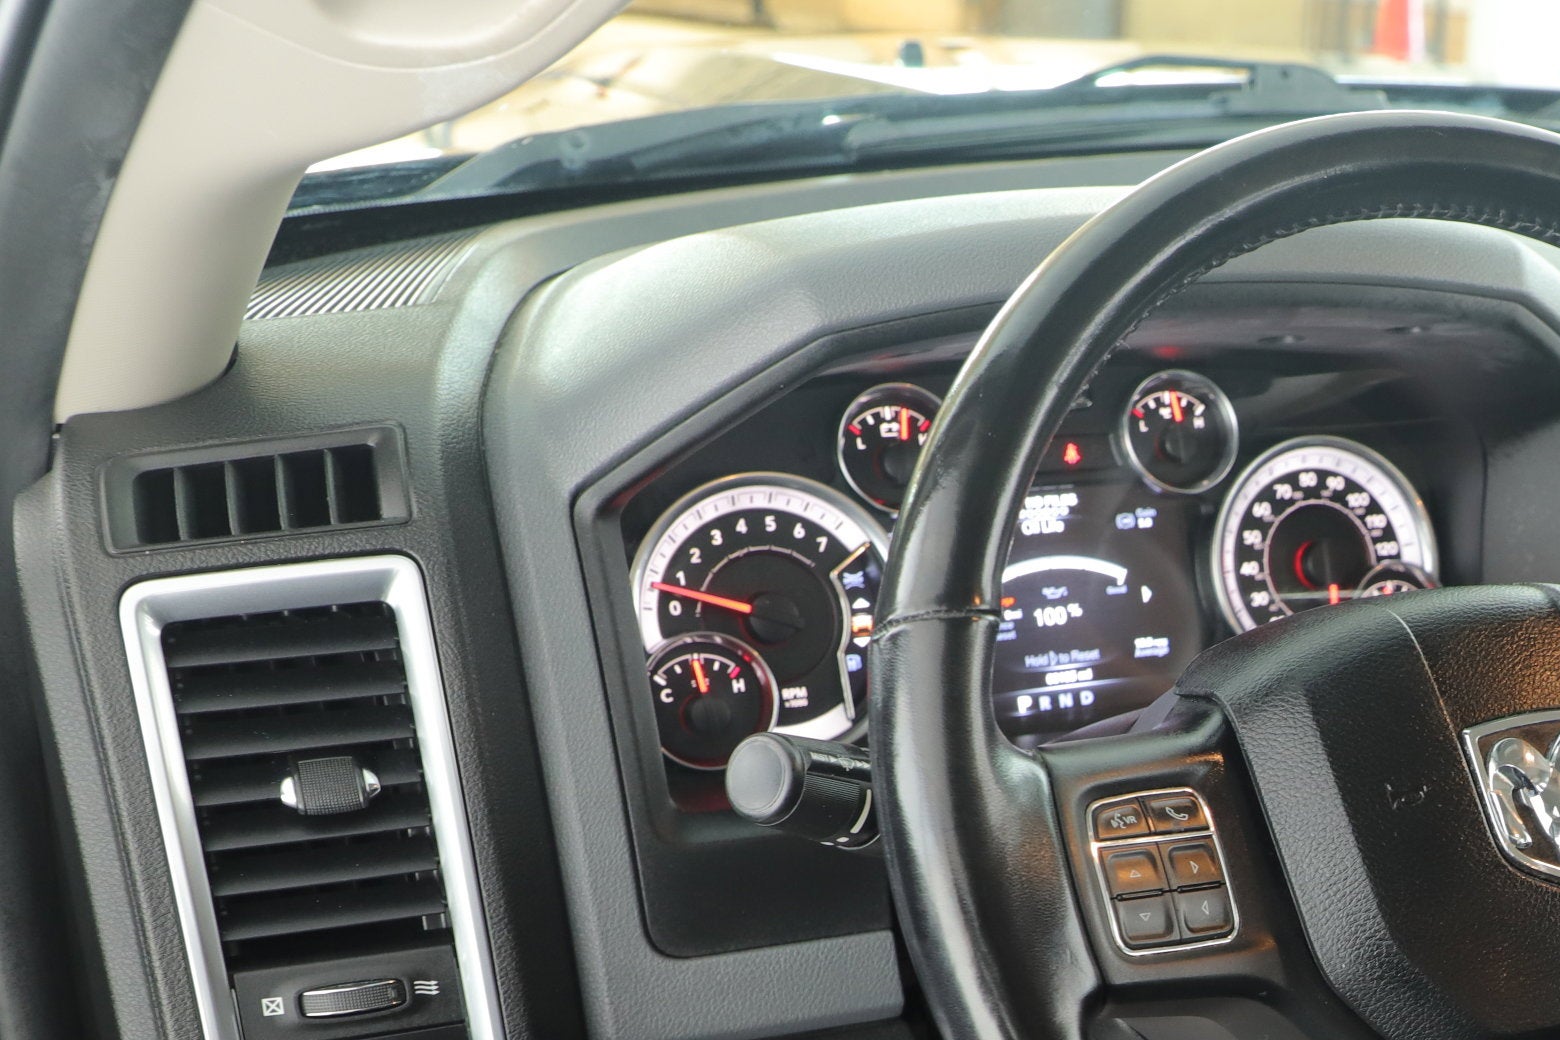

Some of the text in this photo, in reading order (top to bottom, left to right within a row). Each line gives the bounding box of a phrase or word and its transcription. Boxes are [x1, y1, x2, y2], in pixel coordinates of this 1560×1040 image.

[1138, 419, 1149, 433] L
[855, 436, 867, 450] L
[1298, 471, 1318, 488] 80
[1325, 475, 1346, 491] 90
[1273, 483, 1293, 500] 70
[1345, 491, 1371, 509] 100
[1251, 501, 1272, 519] 60
[735, 517, 748, 535] 4
[763, 515, 777, 532] 5
[1364, 513, 1388, 530] 110
[709, 529, 723, 546] 3
[792, 522, 806, 539] 6
[1242, 529, 1262, 546] 50
[815, 536, 828, 553] 7
[1374, 541, 1399, 557] 120
[688, 547, 702, 564] 2
[1239, 560, 1260, 576] 40
[675, 570, 686, 586] 1
[1250, 590, 1270, 607] 30
[668, 600, 682, 616] 0
[731, 678, 746, 694] H
[781, 686, 808, 701] RPM
[660, 688, 674, 704] C
[1017, 690, 1095, 714] P R N D
[1124, 815, 1138, 826] VR
